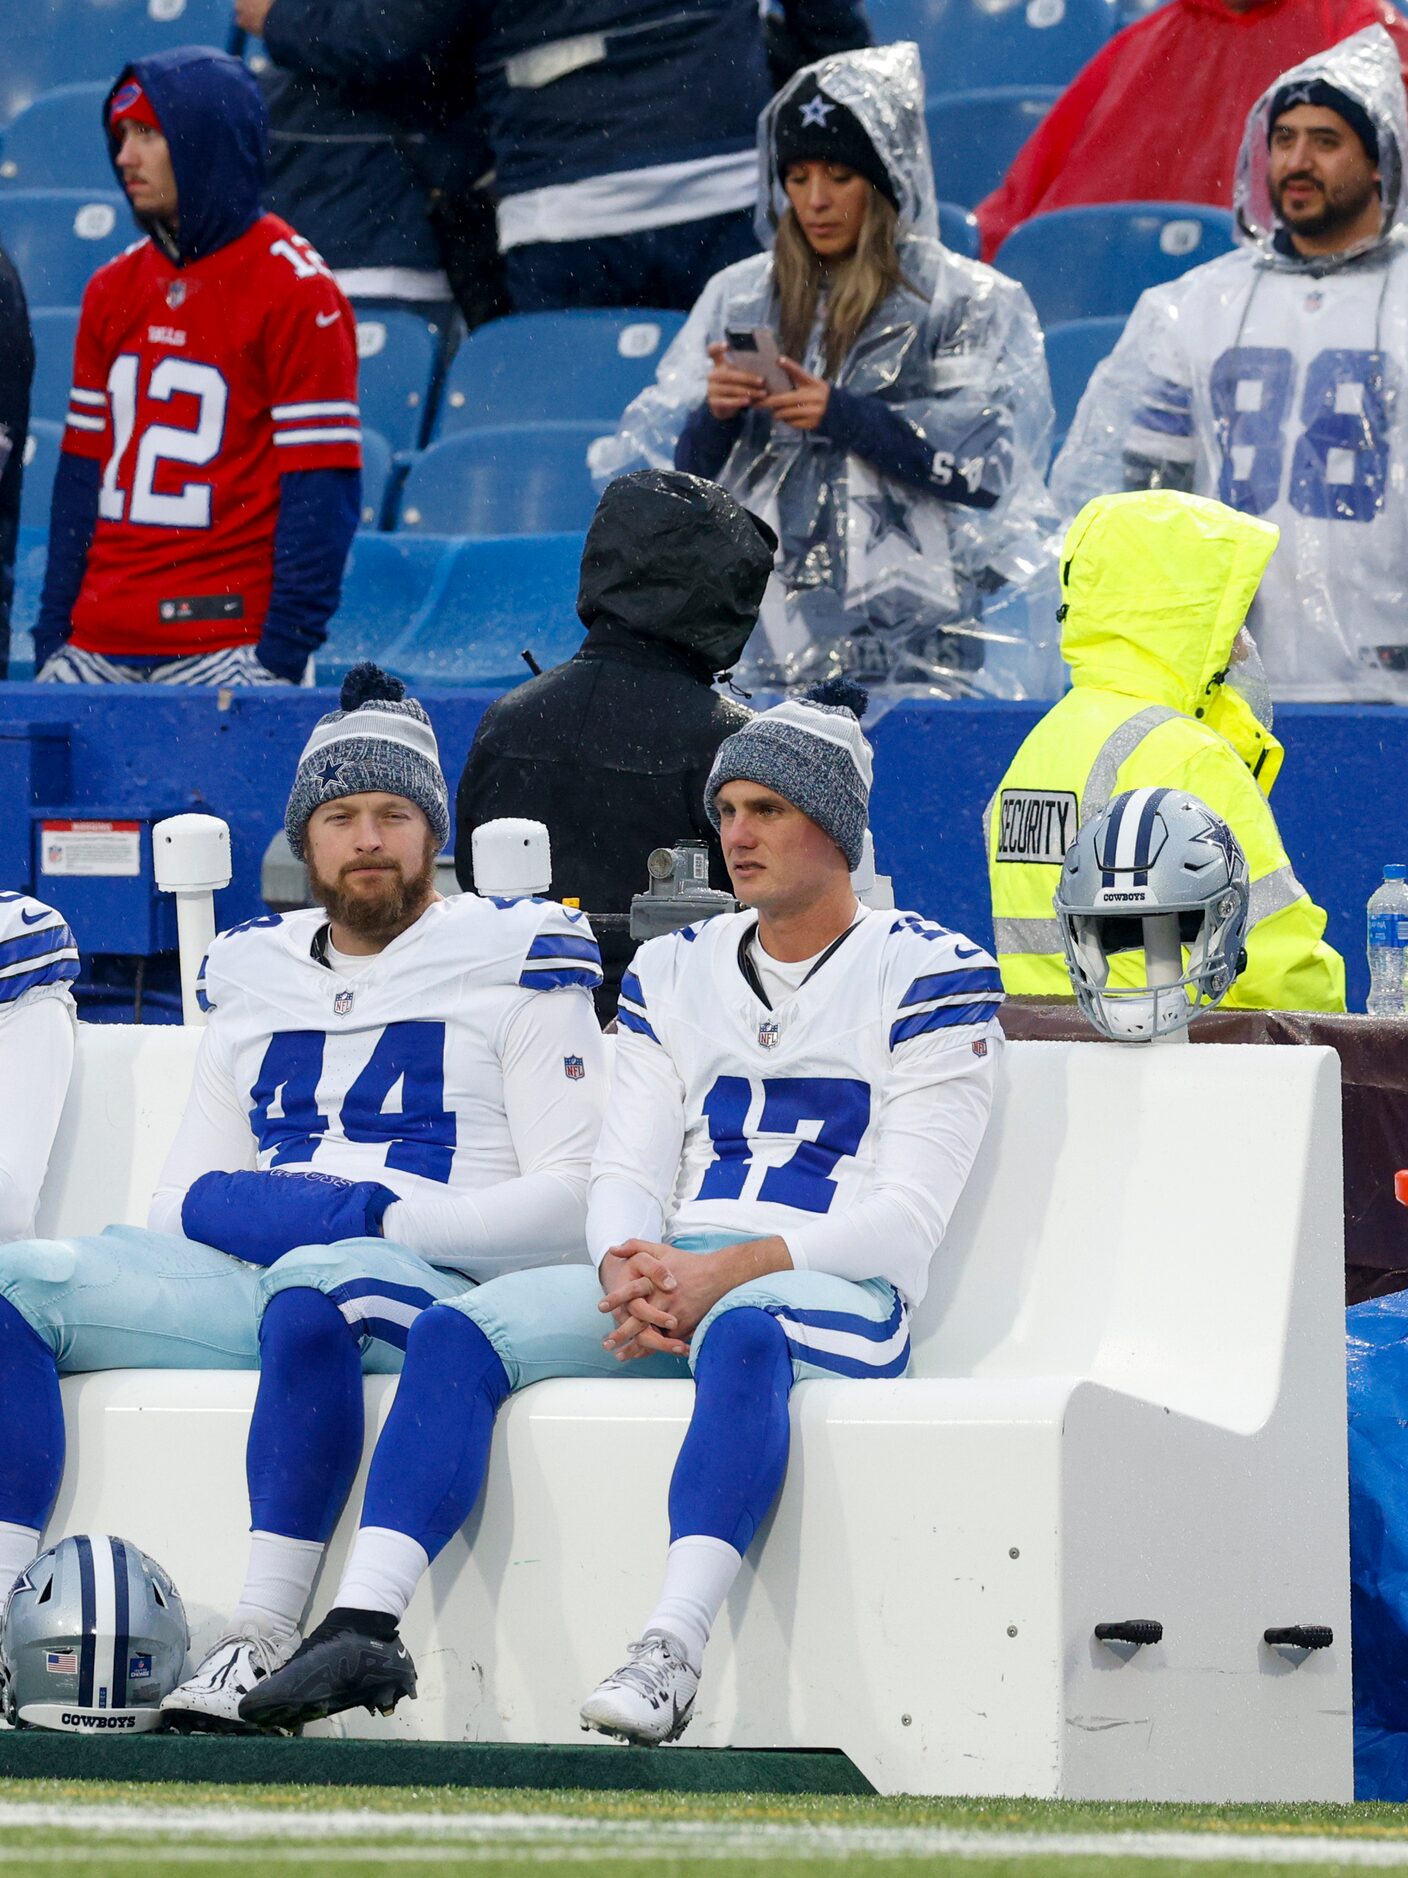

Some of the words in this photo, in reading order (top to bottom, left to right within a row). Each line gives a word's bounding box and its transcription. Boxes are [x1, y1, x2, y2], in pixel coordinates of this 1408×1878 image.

[98, 352, 228, 529] 12
[1209, 346, 1389, 522] 88
[1103, 892, 1147, 902] COWBOYS
[248, 1020, 457, 1184] 44
[693, 1075, 872, 1214] 17
[61, 1712, 136, 1729] COWBOYS
